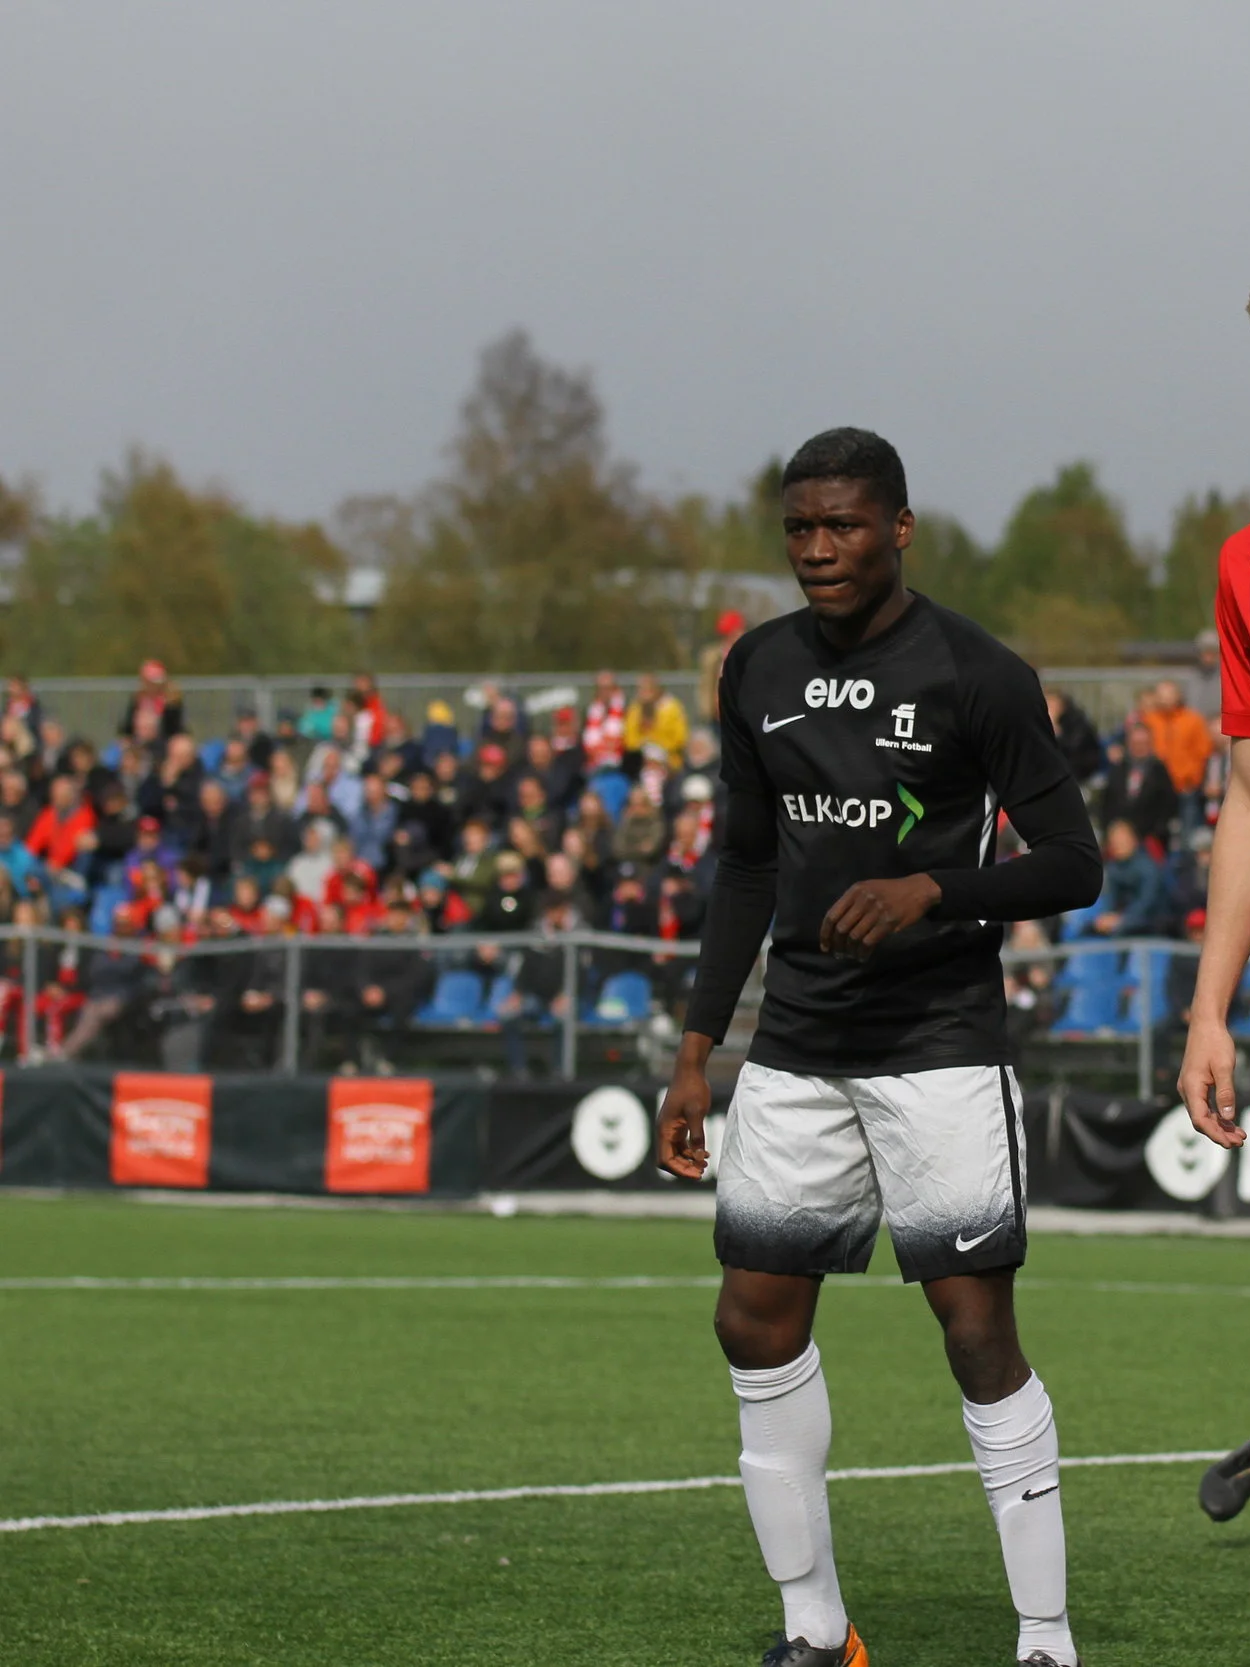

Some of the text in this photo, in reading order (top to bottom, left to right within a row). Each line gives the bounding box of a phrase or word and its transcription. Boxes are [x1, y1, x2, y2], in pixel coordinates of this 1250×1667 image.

[804, 677, 875, 710] evo
[875, 737, 932, 753] Ullern Fotball
